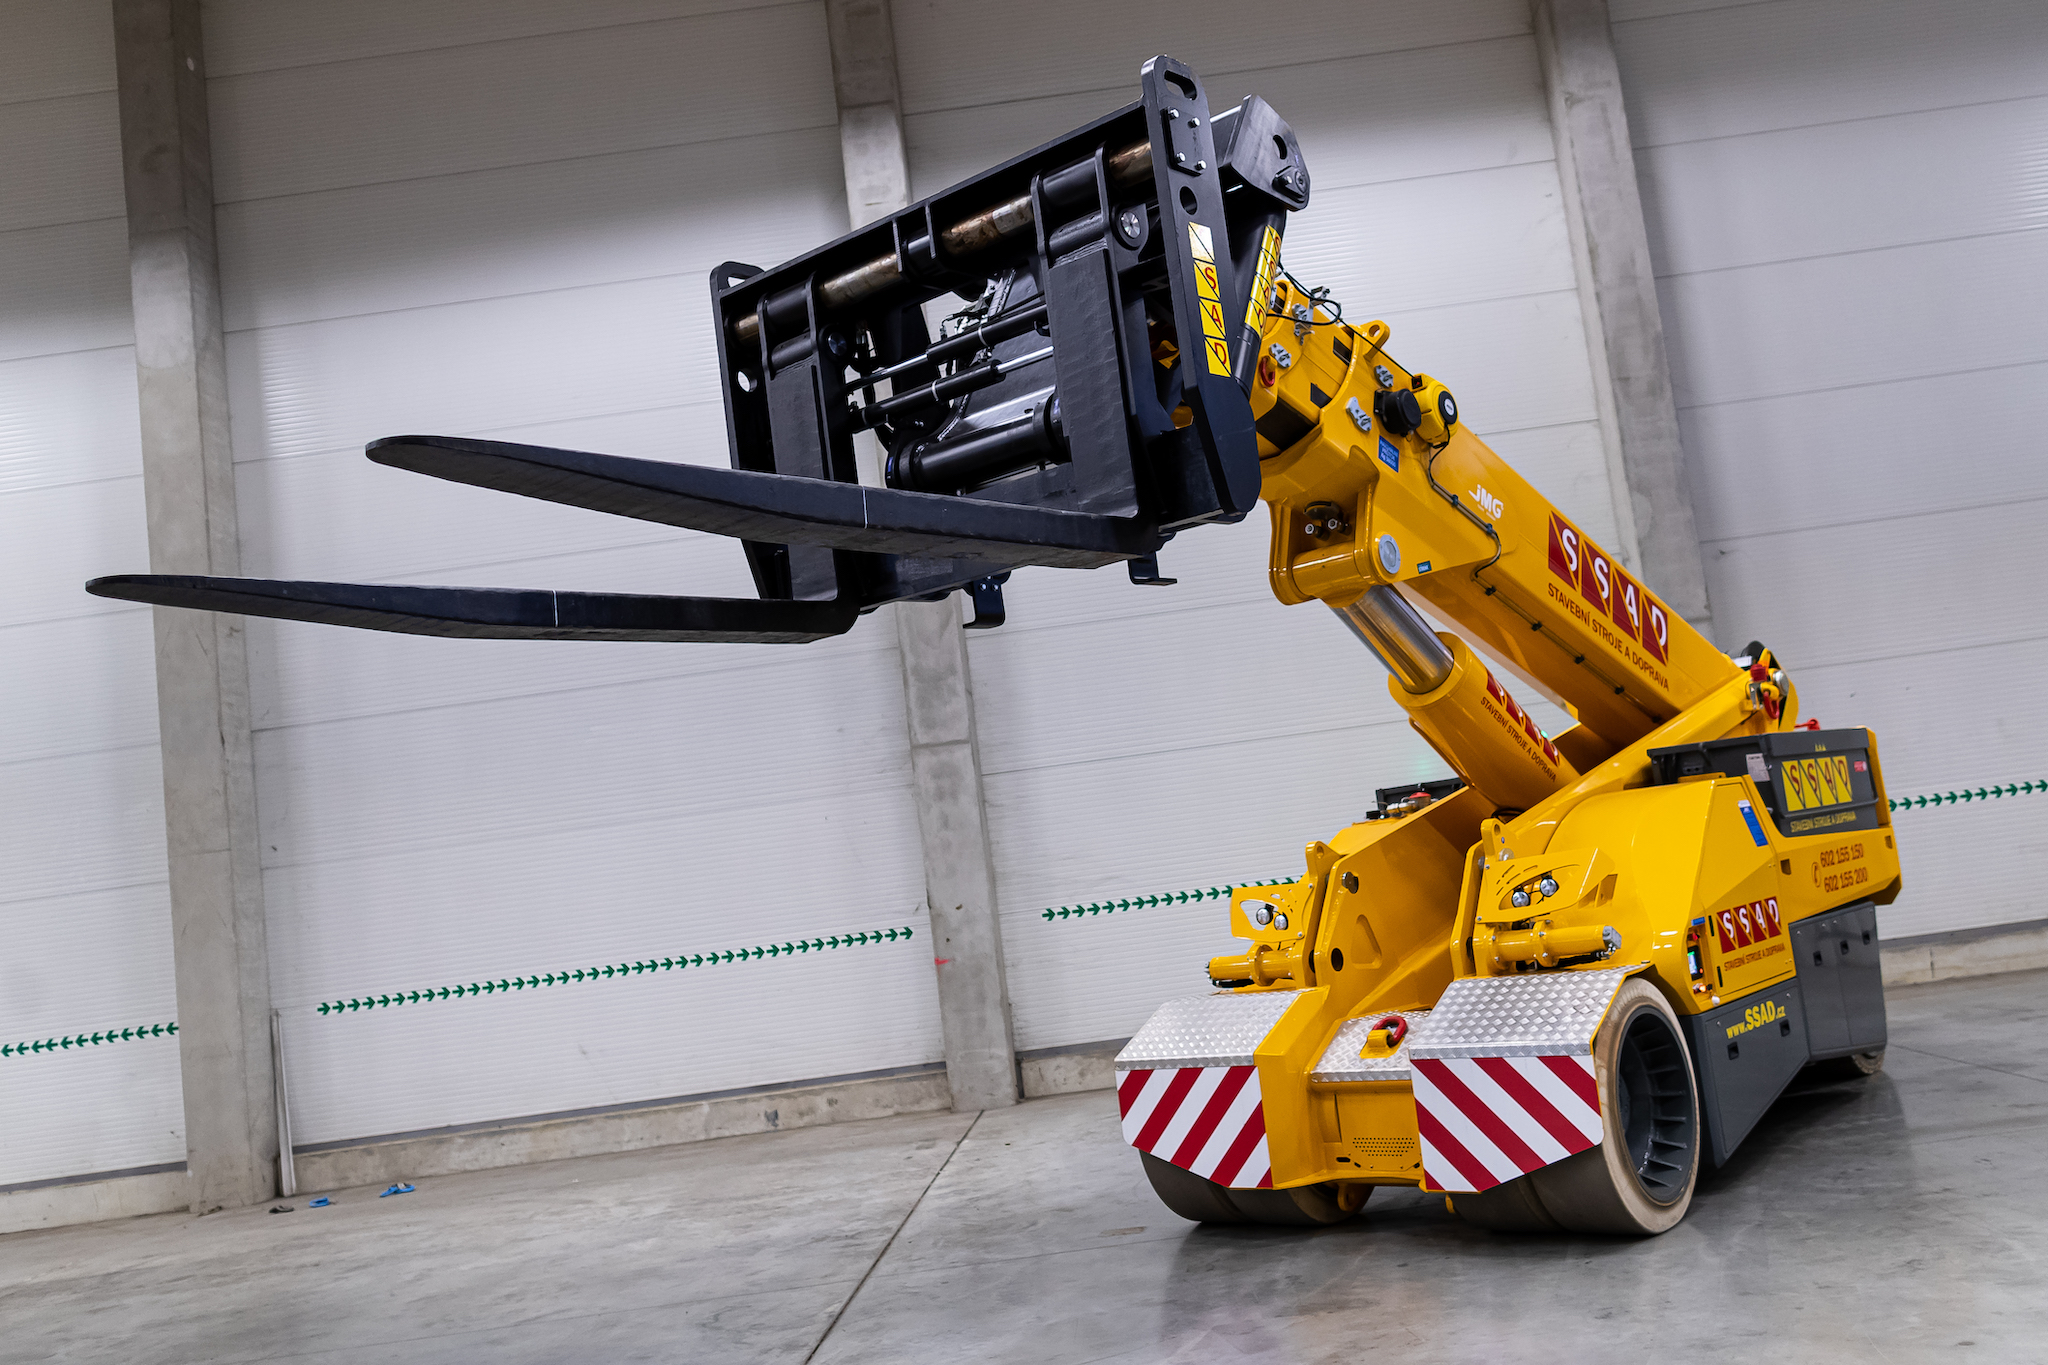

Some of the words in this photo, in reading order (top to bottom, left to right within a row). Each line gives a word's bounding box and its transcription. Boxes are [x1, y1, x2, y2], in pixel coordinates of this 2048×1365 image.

[1562, 528, 1667, 647] SSAD
[1548, 583, 1590, 627] STAVEBNÍ
[1592, 618, 1623, 654] STROJE
[1624, 646, 1631, 660] A
[1632, 653, 1669, 692] DOPRAVA
[1481, 697, 1508, 728] STAVEBNÍ
[1507, 725, 1528, 751] STROJE
[1526, 747, 1532, 756] A
[1531, 752, 1556, 782] DOPRAVA
[1789, 759, 1848, 796] SSAD
[1820, 850, 1835, 868] 602
[1824, 874, 1839, 892] 602
[1723, 899, 1779, 938] SSAD
[1726, 1000, 1786, 1039] www.SSAD.cz
